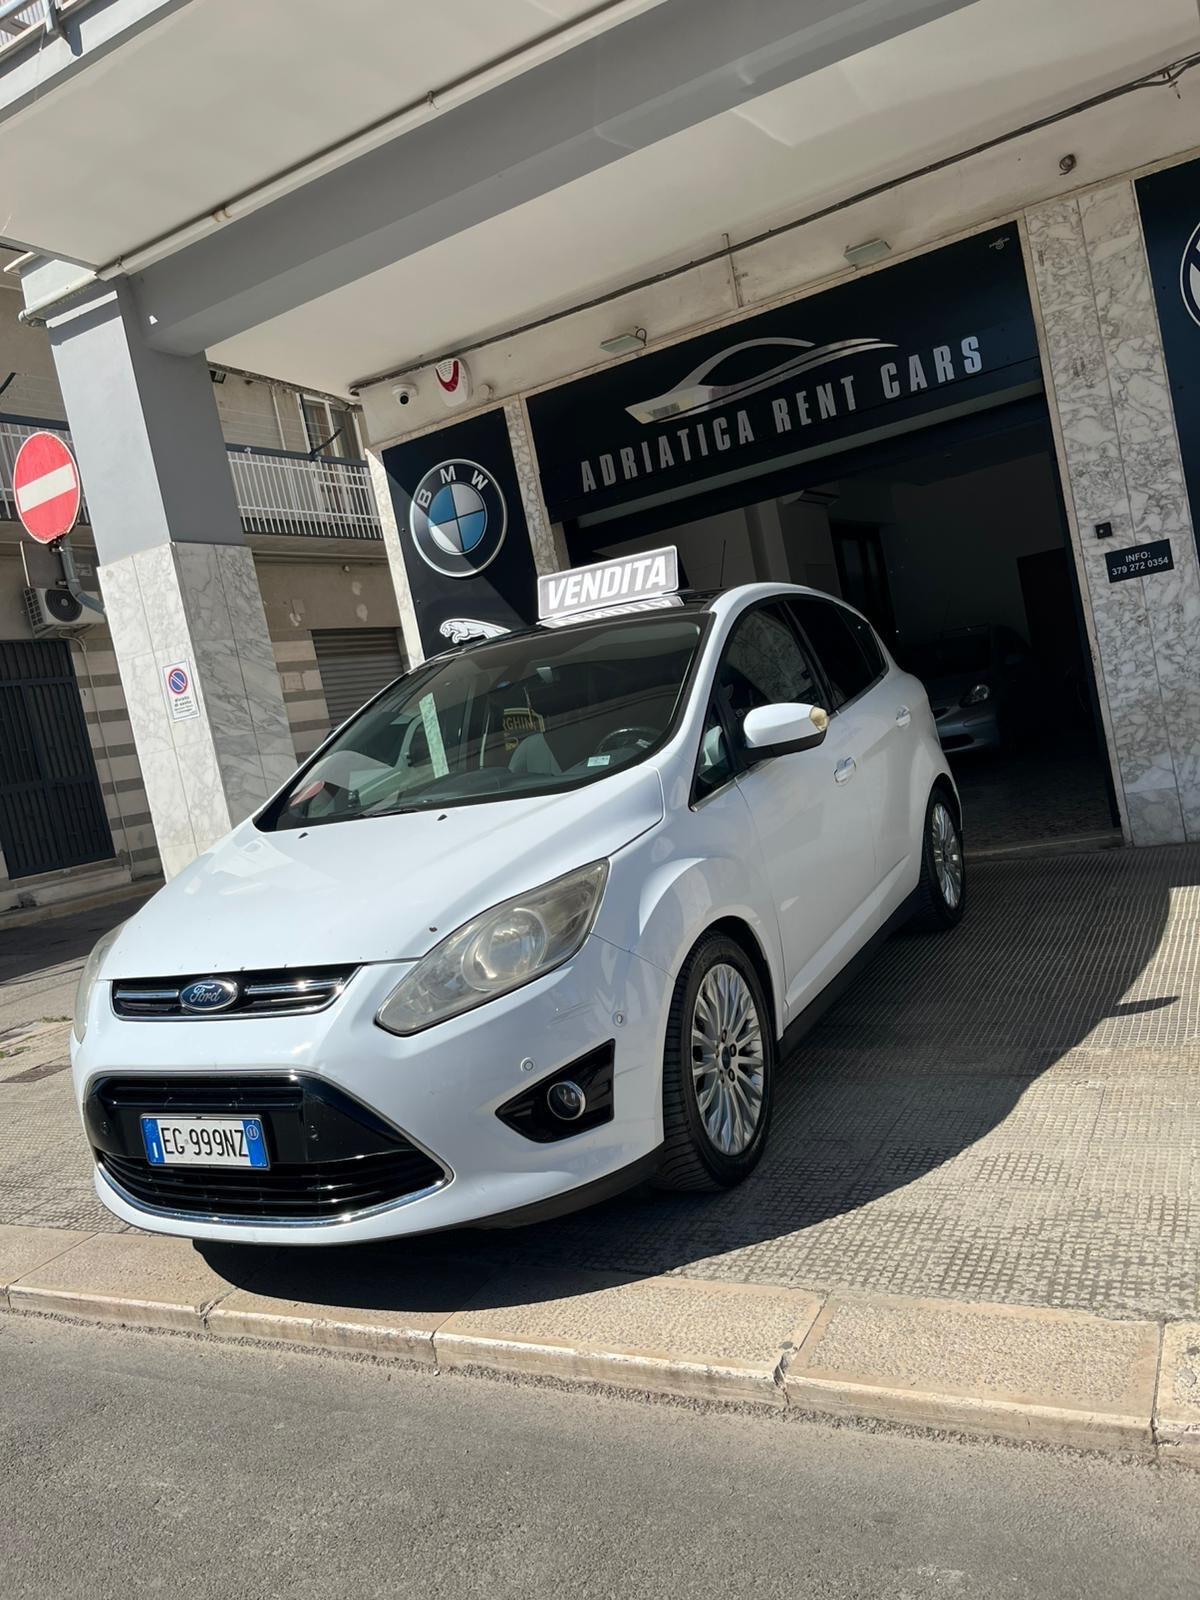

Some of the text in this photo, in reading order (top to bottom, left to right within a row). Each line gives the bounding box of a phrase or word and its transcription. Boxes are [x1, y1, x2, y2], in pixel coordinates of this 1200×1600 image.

[580, 335, 983, 493] ADRIATICA RENT CARS
[416, 465, 489, 509] BMW
[1111, 556, 1169, 576] 379 272 0354
[1125, 551, 1151, 563] INFO:
[548, 555, 667, 610] VENDITA
[189, 984, 222, 1003] Ford
[160, 1127, 249, 1158] EG 999NZ
